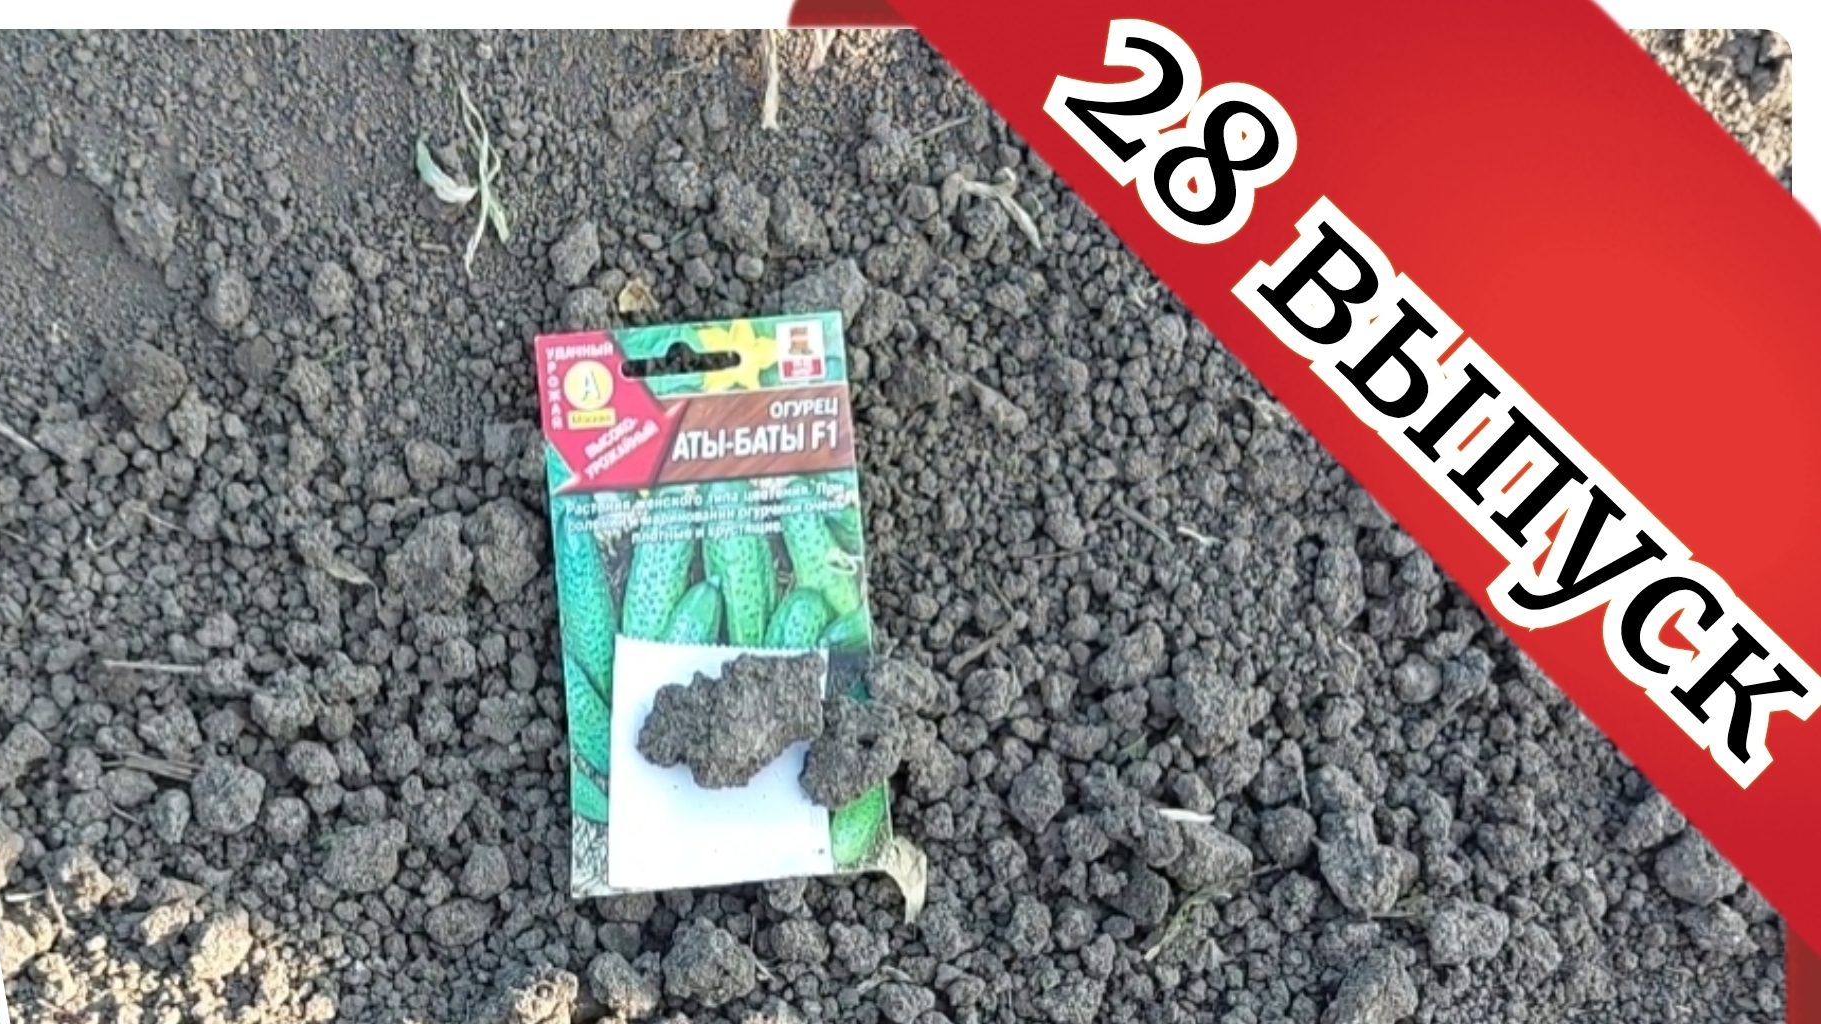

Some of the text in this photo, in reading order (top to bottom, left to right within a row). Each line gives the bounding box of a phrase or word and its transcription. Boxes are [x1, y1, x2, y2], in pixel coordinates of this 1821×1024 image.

[769, 397, 839, 419] ОГУРЕЦ
[672, 420, 838, 462] АТЫ-БАТЫ F1
